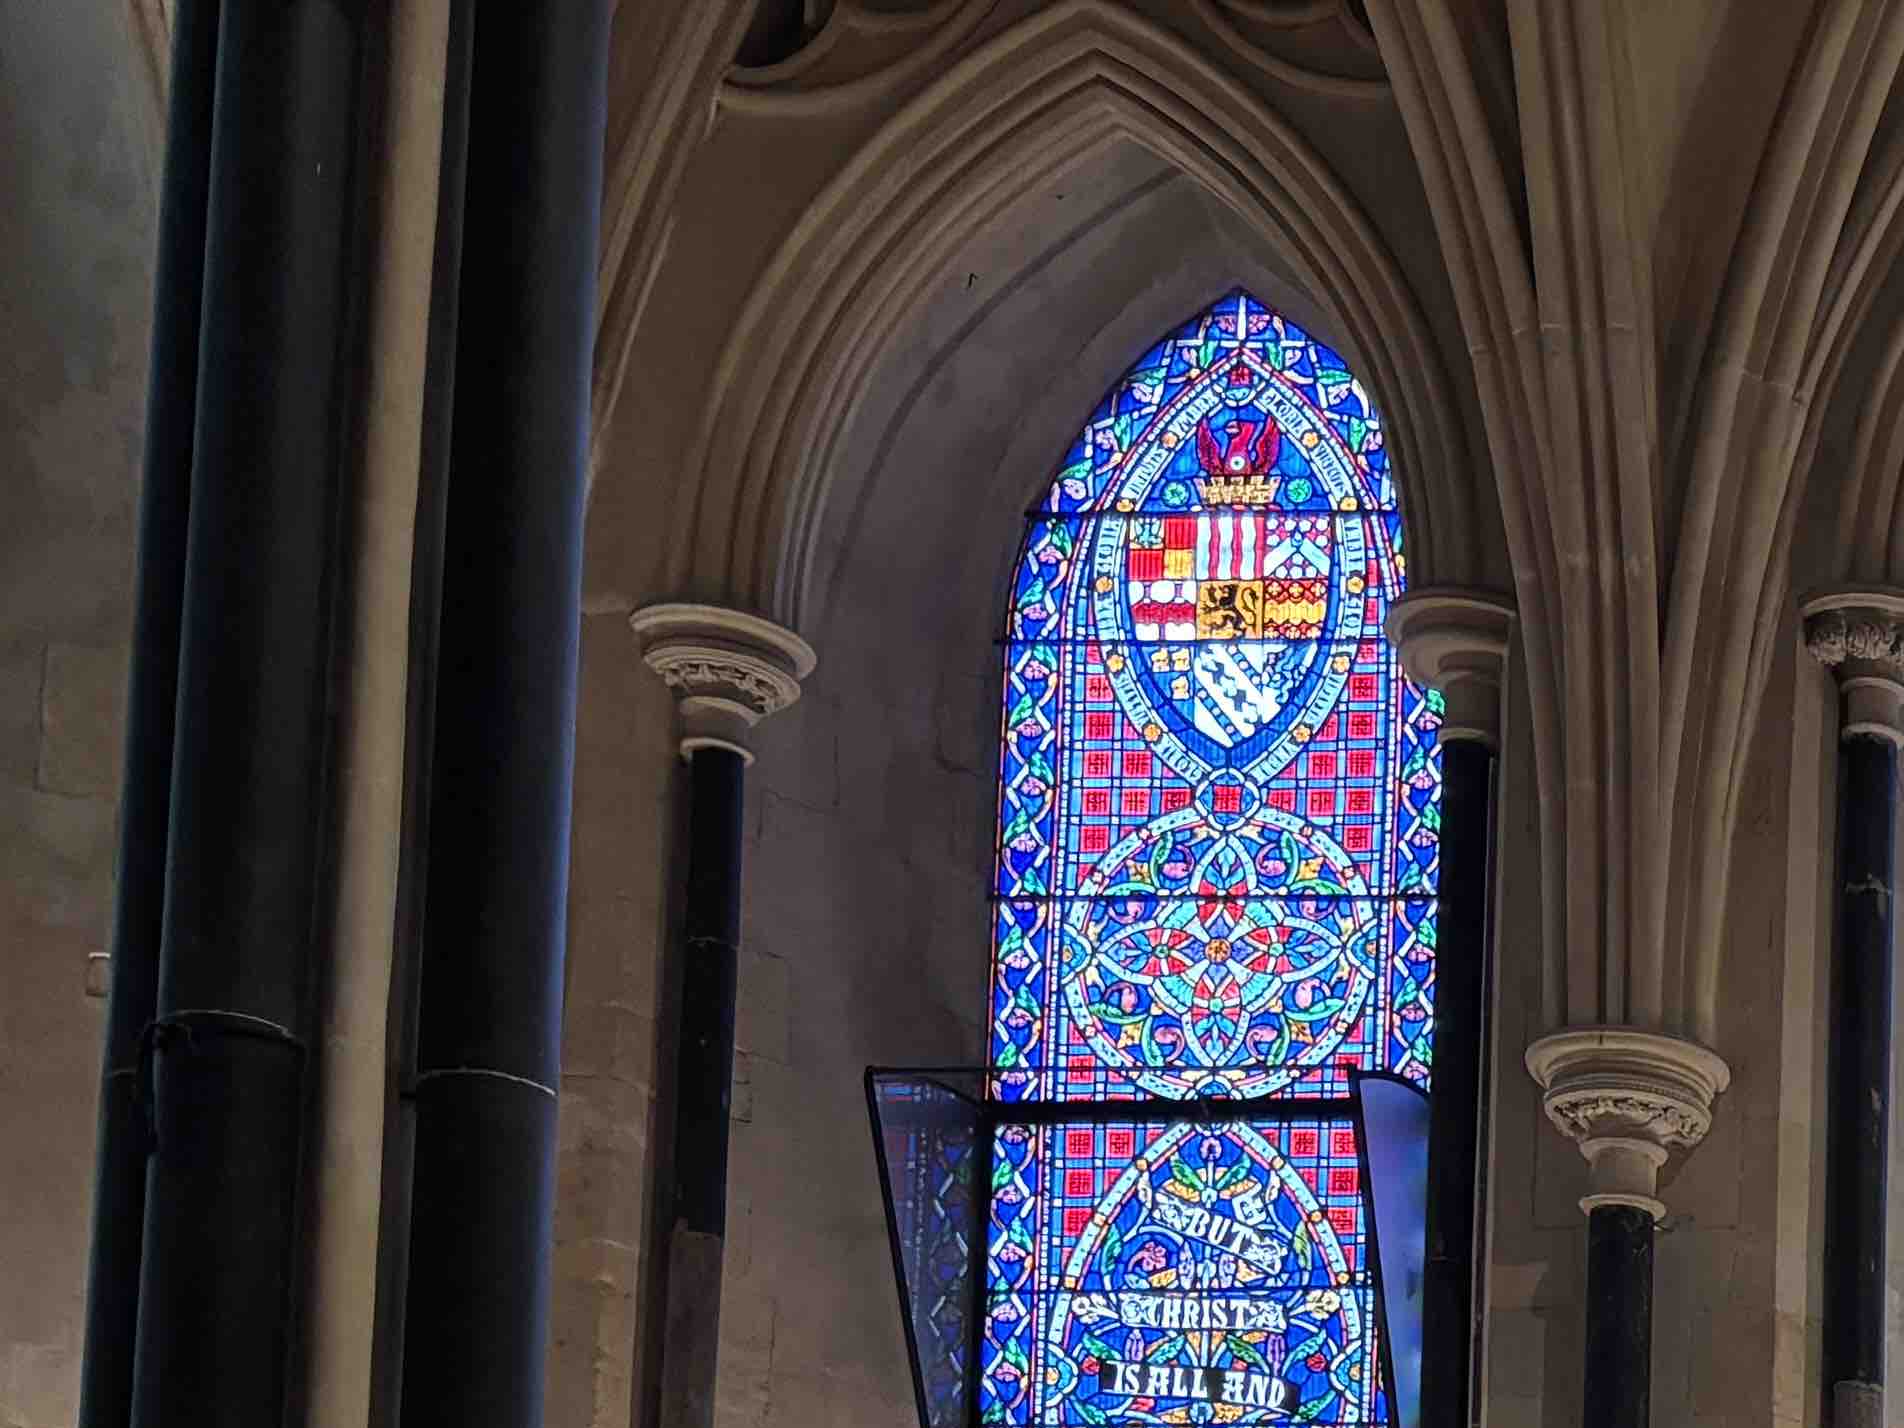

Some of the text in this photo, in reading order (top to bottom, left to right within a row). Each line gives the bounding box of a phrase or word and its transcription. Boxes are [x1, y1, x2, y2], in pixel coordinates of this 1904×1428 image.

[1184, 1207, 1252, 1255] BUT
[1147, 1299, 1251, 1329] CHRIST
[1114, 1362, 1286, 1409] IS ALL AND
